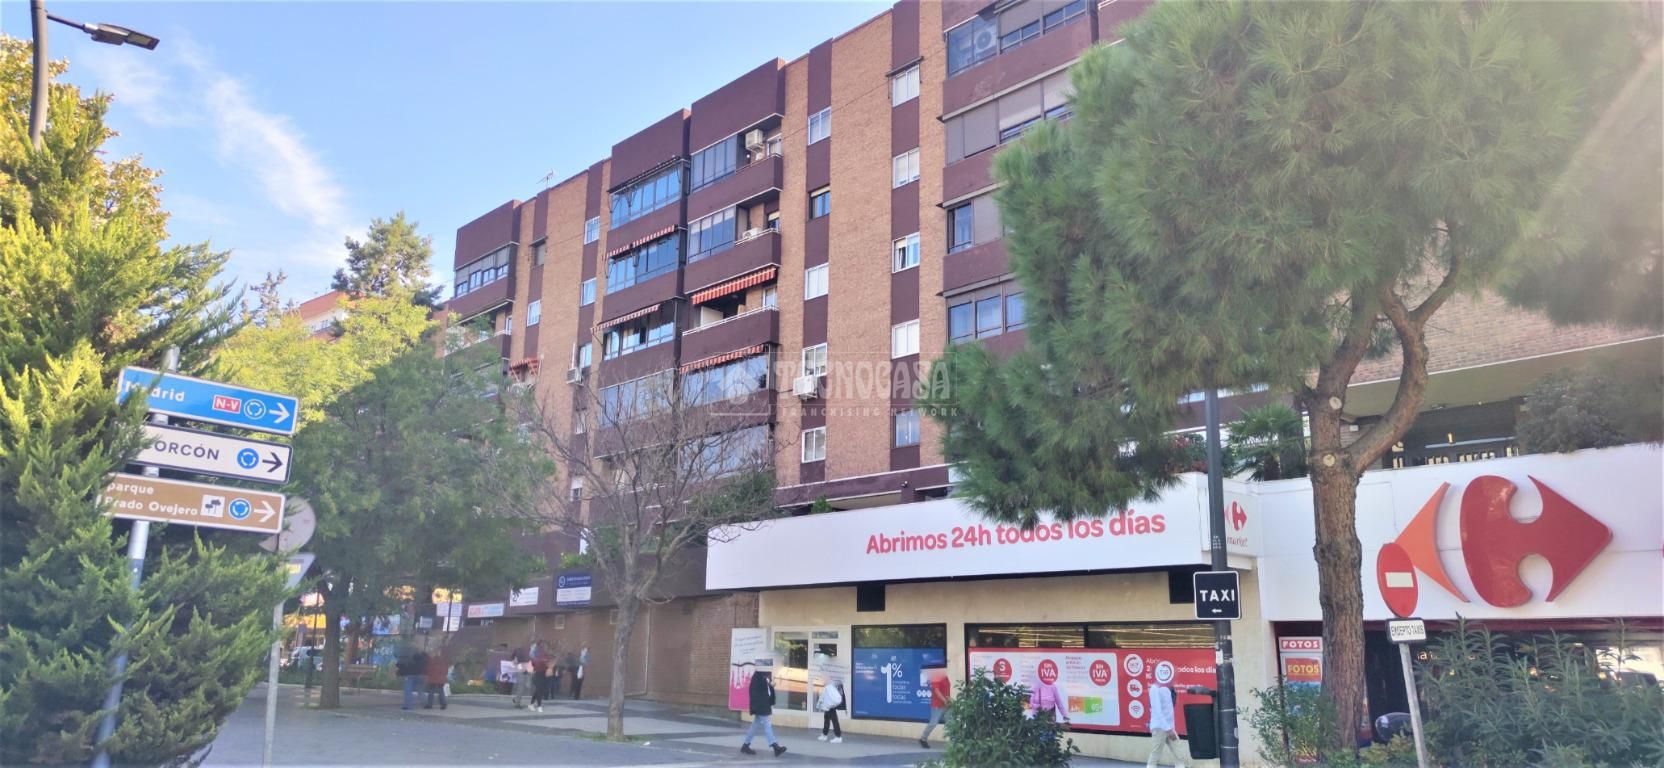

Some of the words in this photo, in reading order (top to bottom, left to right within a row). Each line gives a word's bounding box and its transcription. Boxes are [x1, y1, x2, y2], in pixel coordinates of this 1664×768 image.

[125, 380, 185, 402] Mdrid
[216, 398, 239, 410] N-V
[154, 440, 219, 460] ORCÓN
[106, 482, 154, 496] parque
[104, 495, 144, 509] Prado
[148, 501, 198, 516] Ovejero
[866, 531, 947, 554] Abrimos
[951, 526, 992, 548] 24h
[996, 521, 1063, 545] todos
[1067, 516, 1104, 540] los
[1109, 507, 1166, 536] días
[1200, 590, 1235, 602] TAXI
[1282, 640, 1319, 649] FOTOS
[1041, 669, 1056, 678] IVA
[1093, 670, 1108, 678] IVA
[1176, 666, 1194, 674] odos
[1287, 664, 1320, 674] FOTOS
